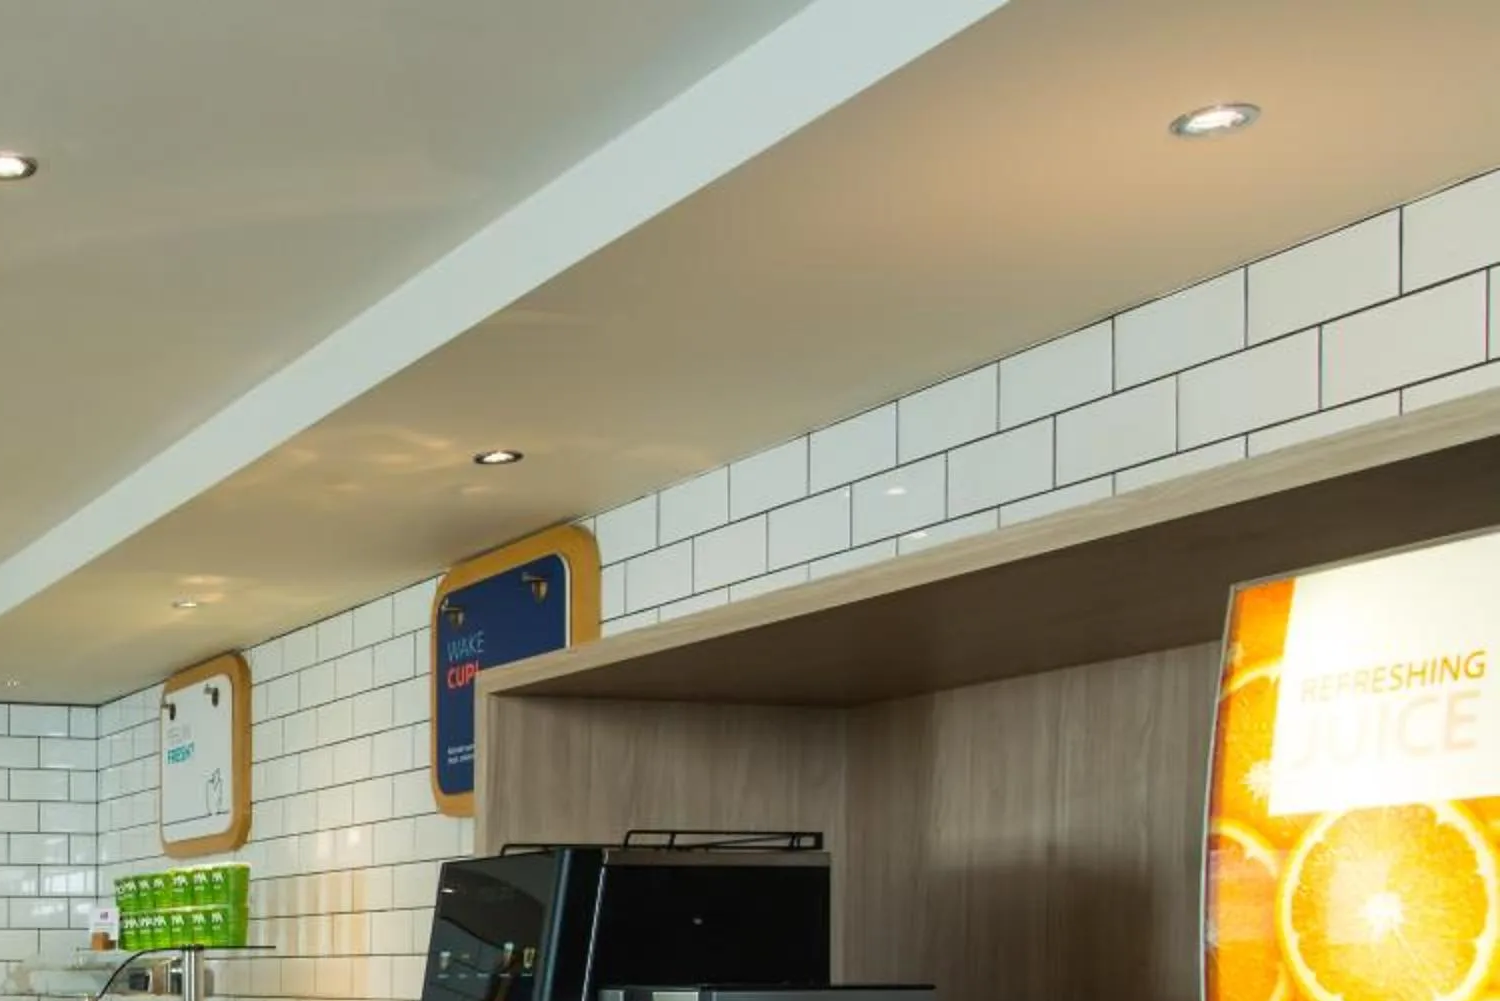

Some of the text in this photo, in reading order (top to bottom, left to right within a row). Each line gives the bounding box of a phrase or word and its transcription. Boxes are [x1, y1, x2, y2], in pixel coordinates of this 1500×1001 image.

[447, 630, 485, 661] WAKE
[1301, 650, 1486, 703] REFRESHING
[1290, 688, 1482, 769] JUICE
